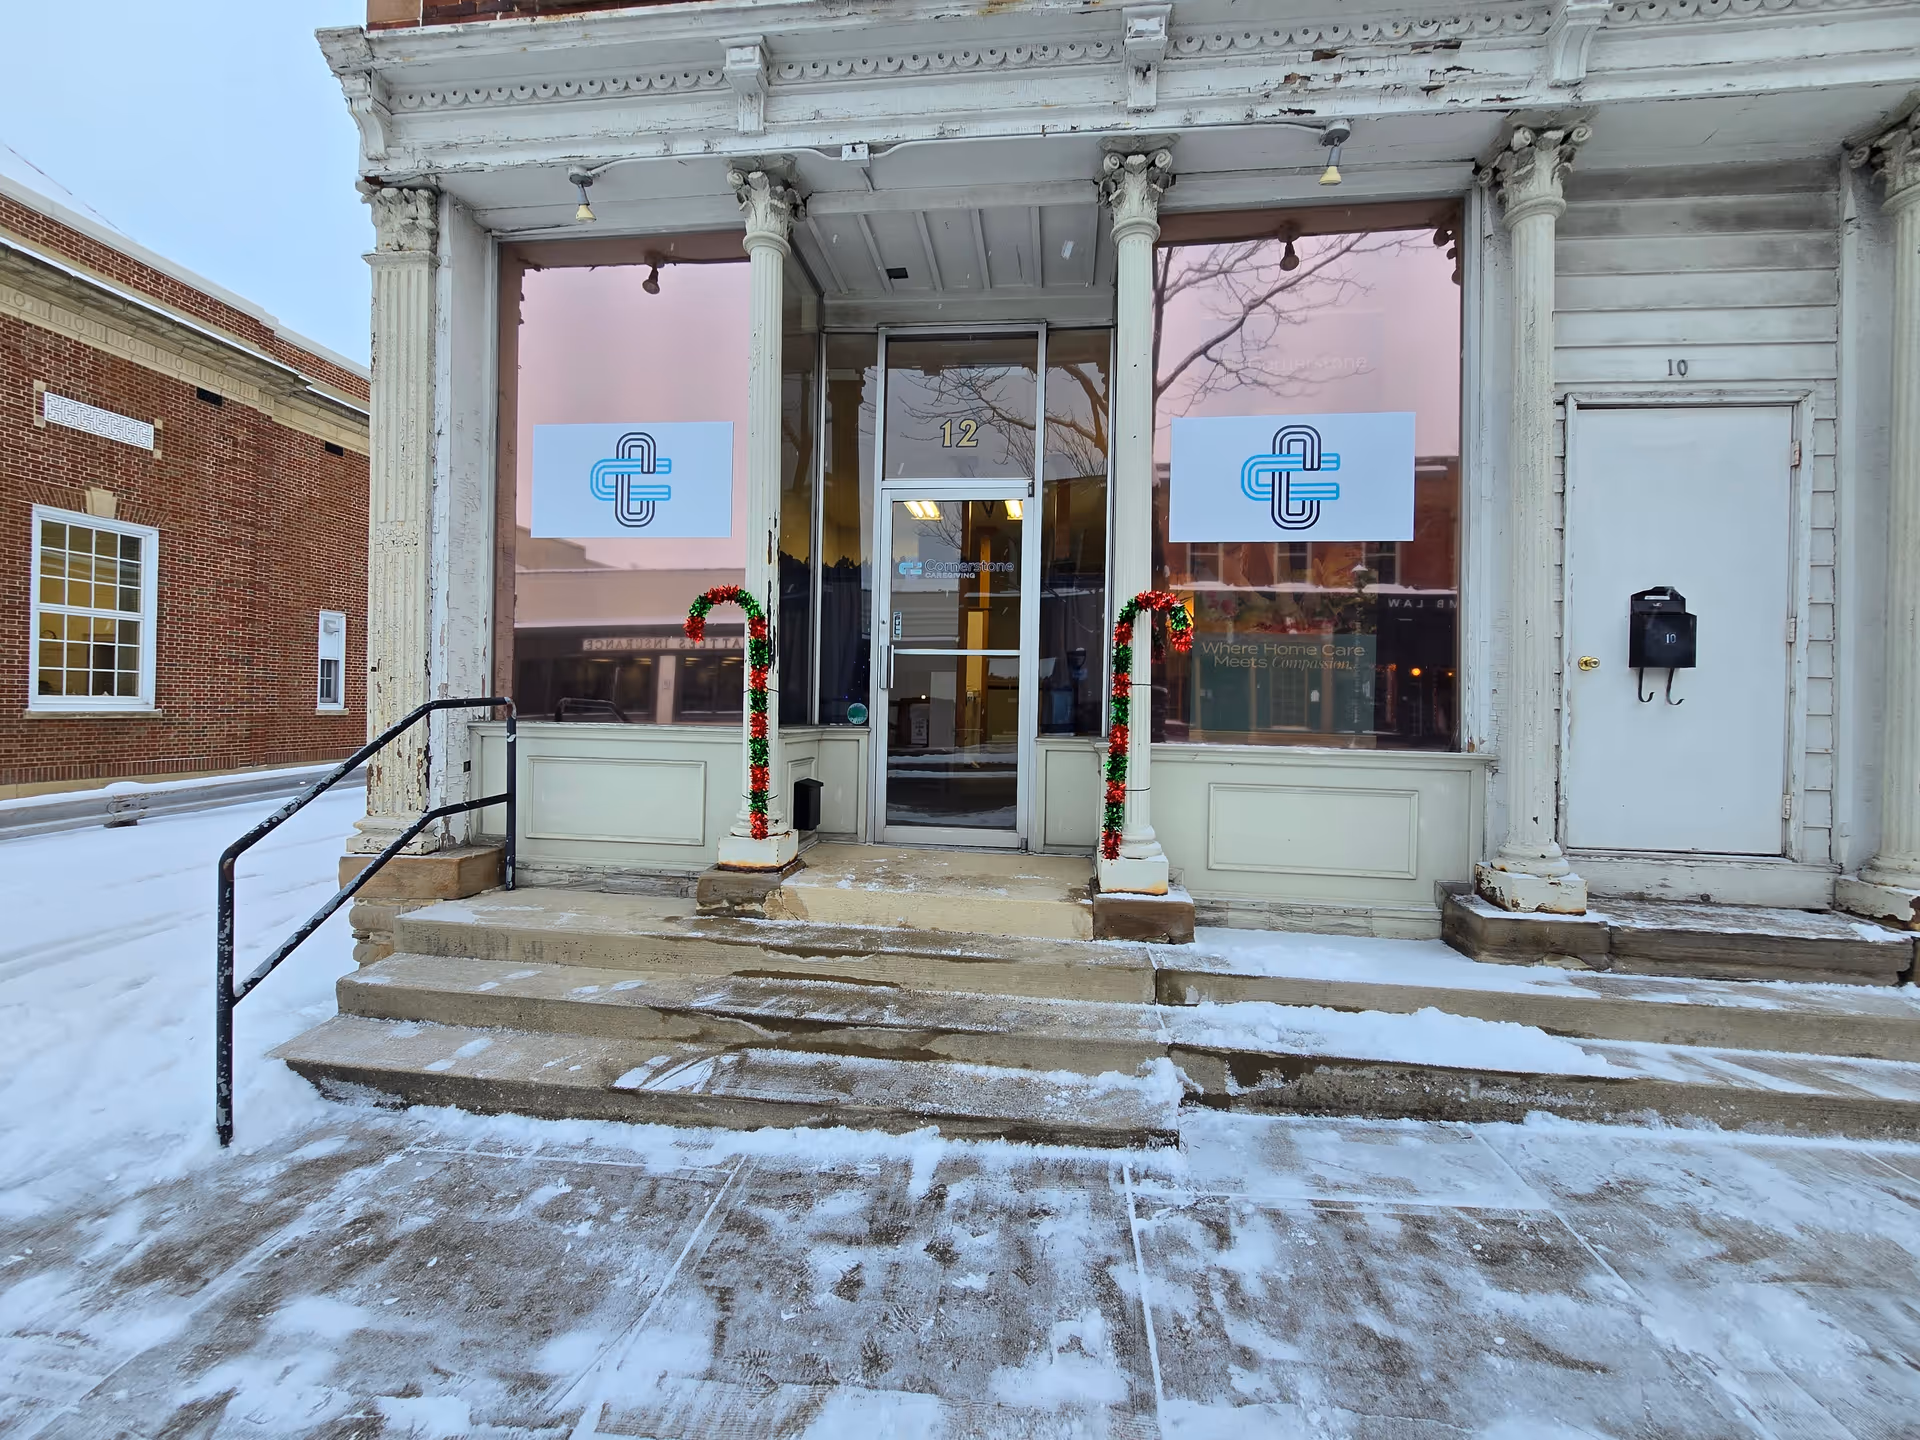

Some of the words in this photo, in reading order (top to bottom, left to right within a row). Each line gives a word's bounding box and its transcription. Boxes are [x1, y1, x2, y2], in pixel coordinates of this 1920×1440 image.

[1667, 358, 1688, 376] 10
[939, 418, 979, 448] 12
[925, 558, 1014, 573] Cornerstone
[1665, 633, 1677, 644] 10
[1202, 642, 1258, 655] Where
[1263, 643, 1318, 656] Home
[1321, 643, 1366, 657] Care
[1214, 655, 1268, 668] Meets
